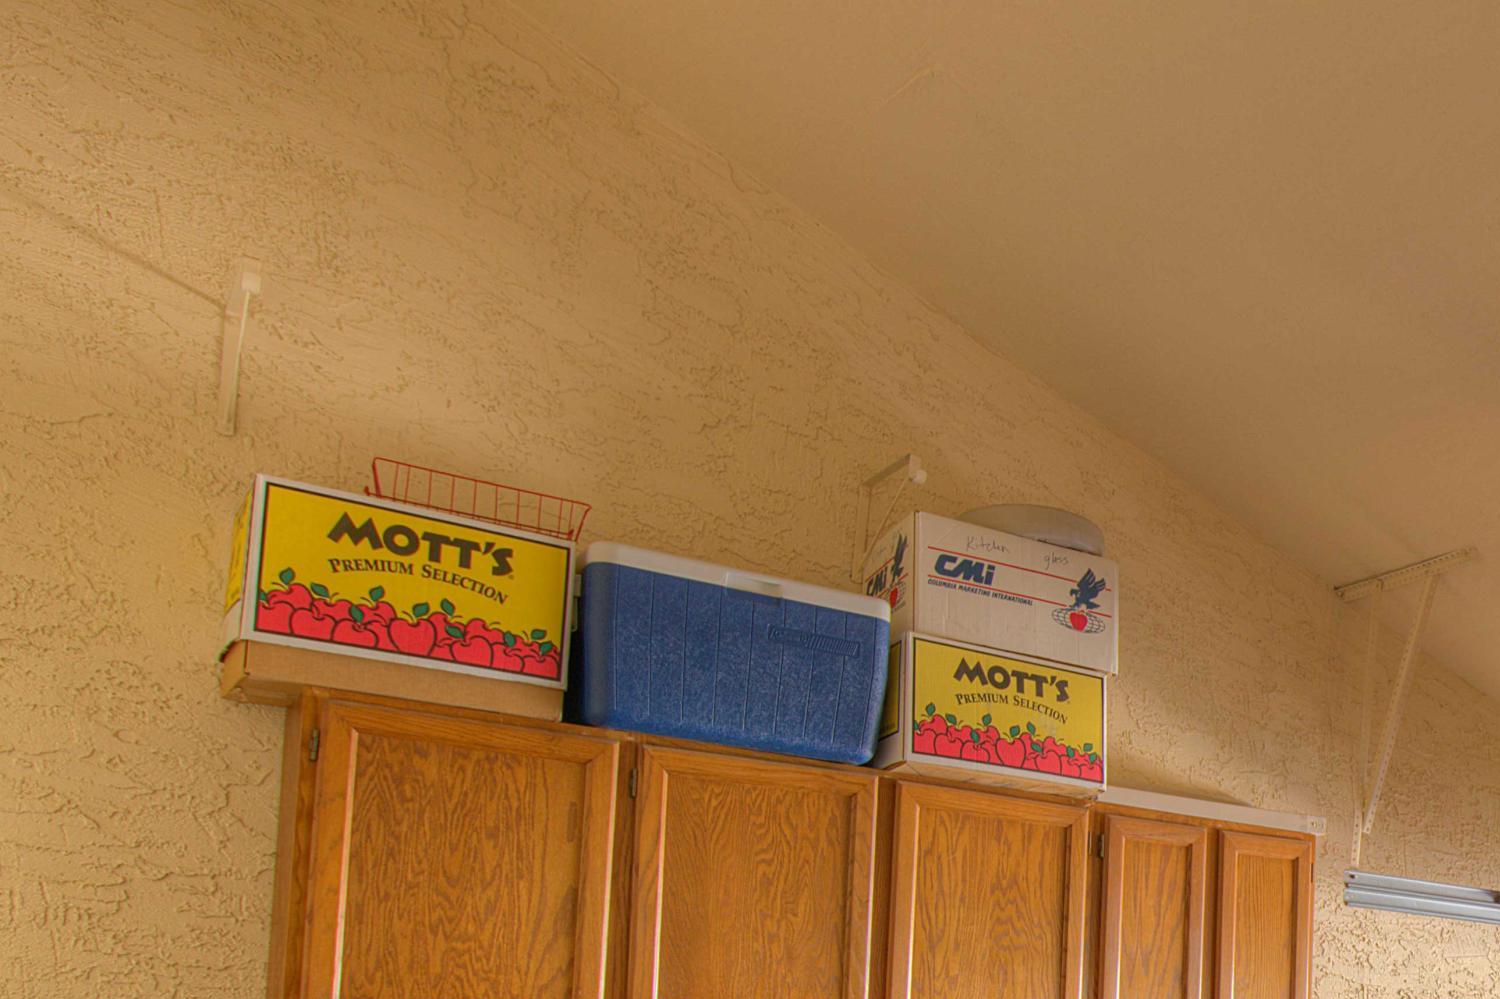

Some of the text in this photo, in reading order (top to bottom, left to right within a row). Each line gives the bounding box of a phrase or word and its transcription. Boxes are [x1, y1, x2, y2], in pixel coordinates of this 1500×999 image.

[327, 512, 514, 576] MOTT'S
[958, 584, 991, 597] MARKETING
[991, 591, 1034, 606] INTERNATIONAL
[953, 657, 1070, 702] MOTT'S
